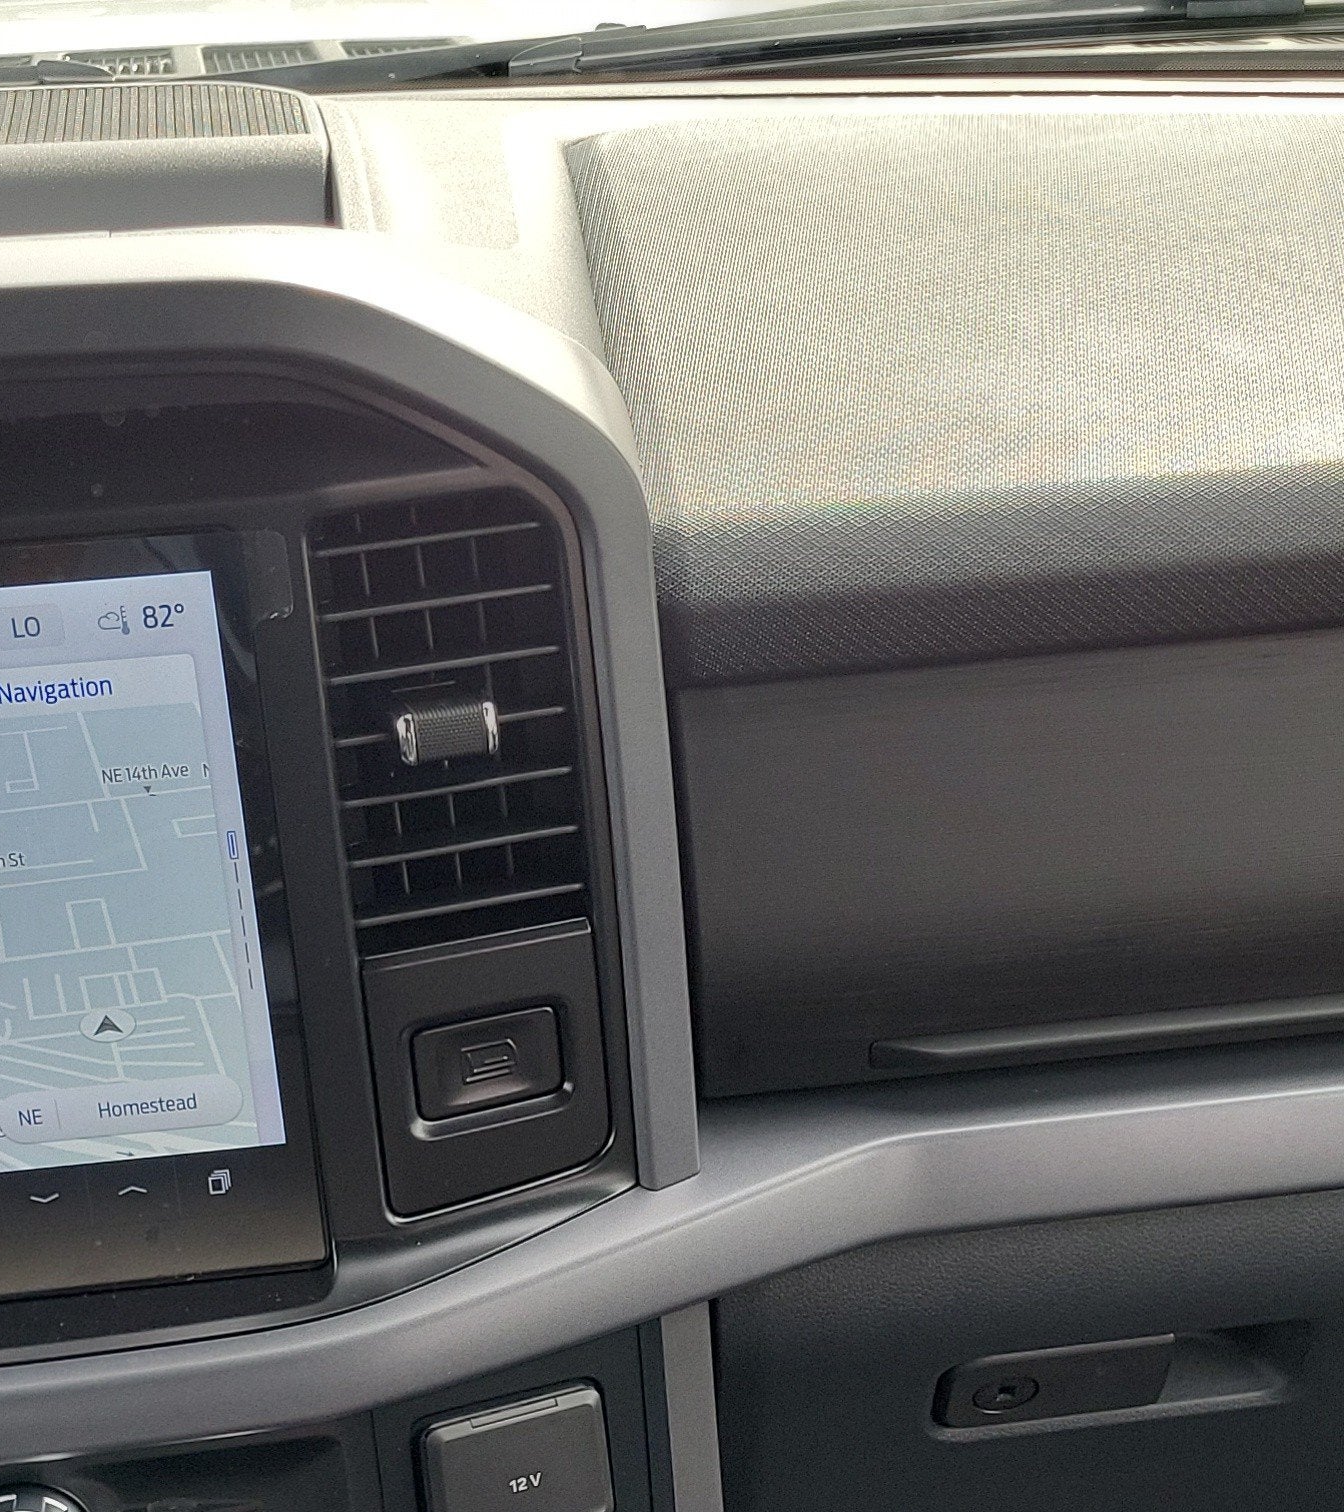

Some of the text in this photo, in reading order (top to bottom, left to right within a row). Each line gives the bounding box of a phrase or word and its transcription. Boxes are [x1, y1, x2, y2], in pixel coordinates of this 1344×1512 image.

[11, 616, 41, 639] LO
[101, 767, 123, 784] NE
[125, 764, 157, 782] 14th
[160, 762, 189, 779] Ave
[8, 852, 25, 868] St
[18, 1107, 43, 1127] NE
[97, 1093, 197, 1120] Homestead
[509, 1472, 542, 1493] 12 V
